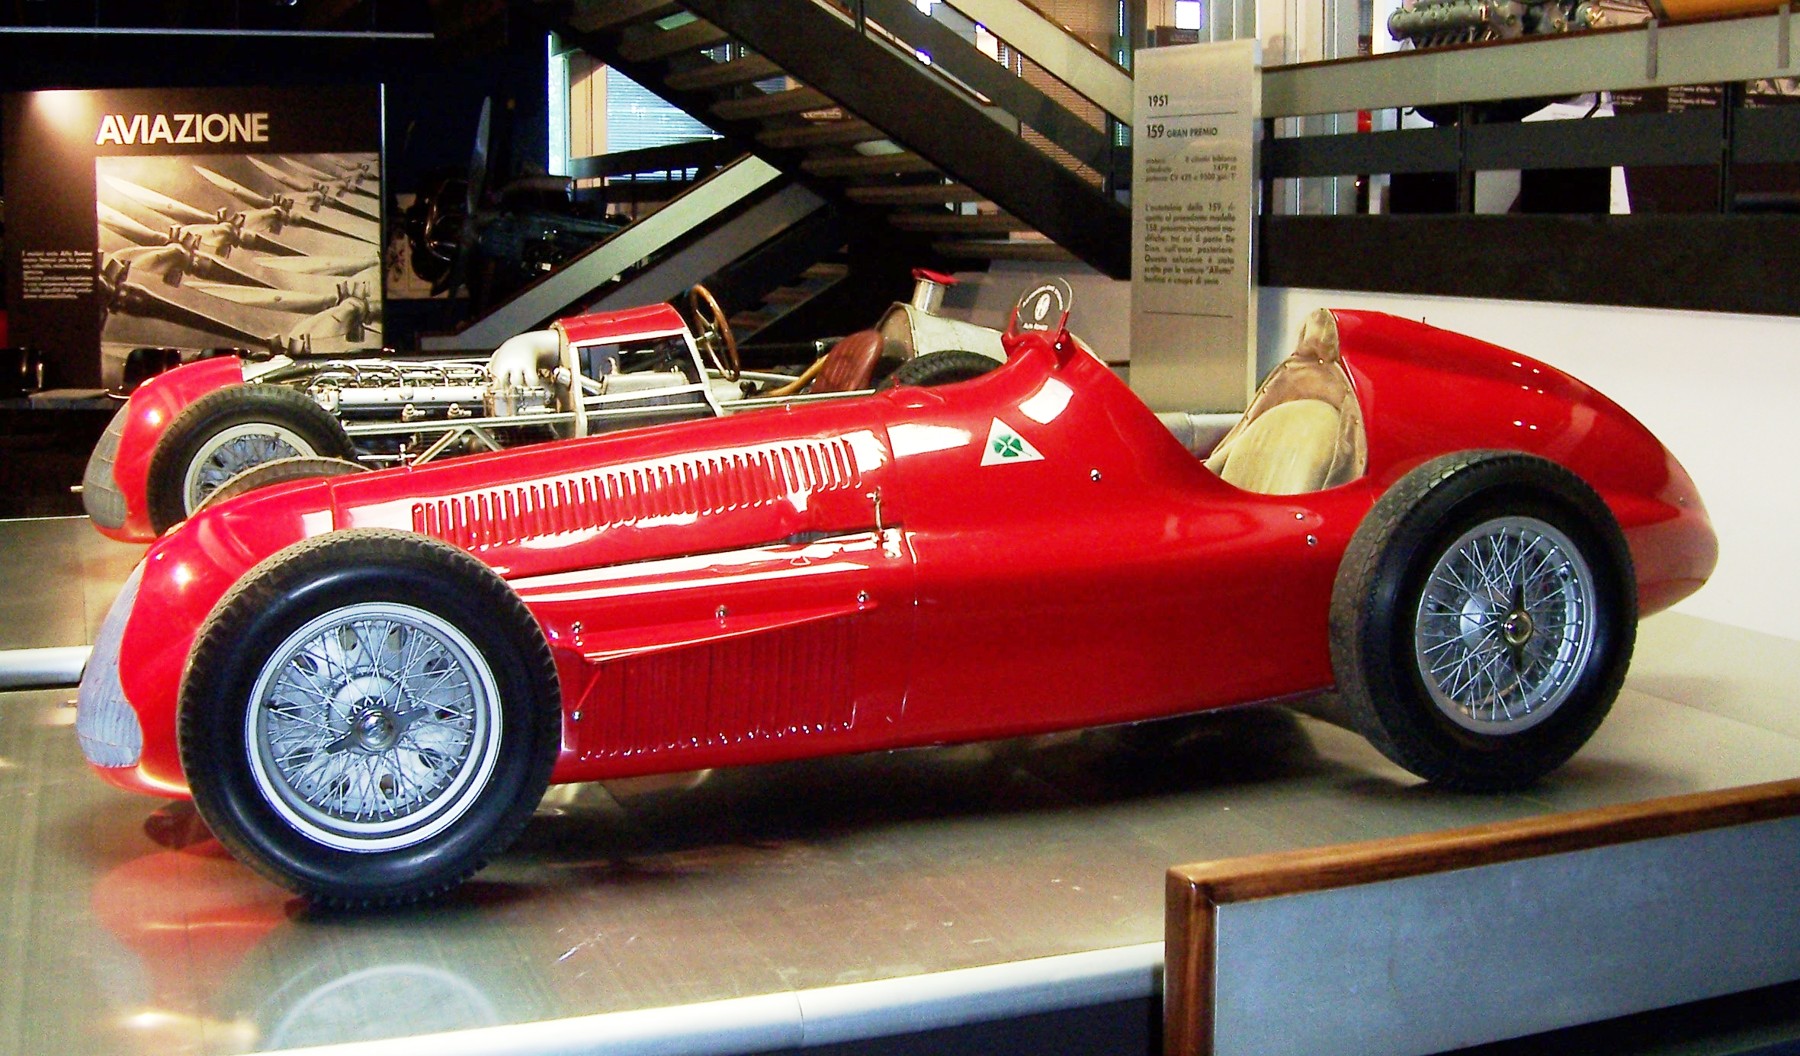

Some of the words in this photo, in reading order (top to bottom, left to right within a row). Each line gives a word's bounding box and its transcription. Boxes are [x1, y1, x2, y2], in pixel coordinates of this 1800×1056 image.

[1148, 94, 1169, 107] 1951
[96, 113, 268, 145] AVIAZIONE
[1146, 124, 1165, 138] 159
[1167, 128, 1188, 138] GRAN
[1190, 127, 1218, 137] PREMIO
